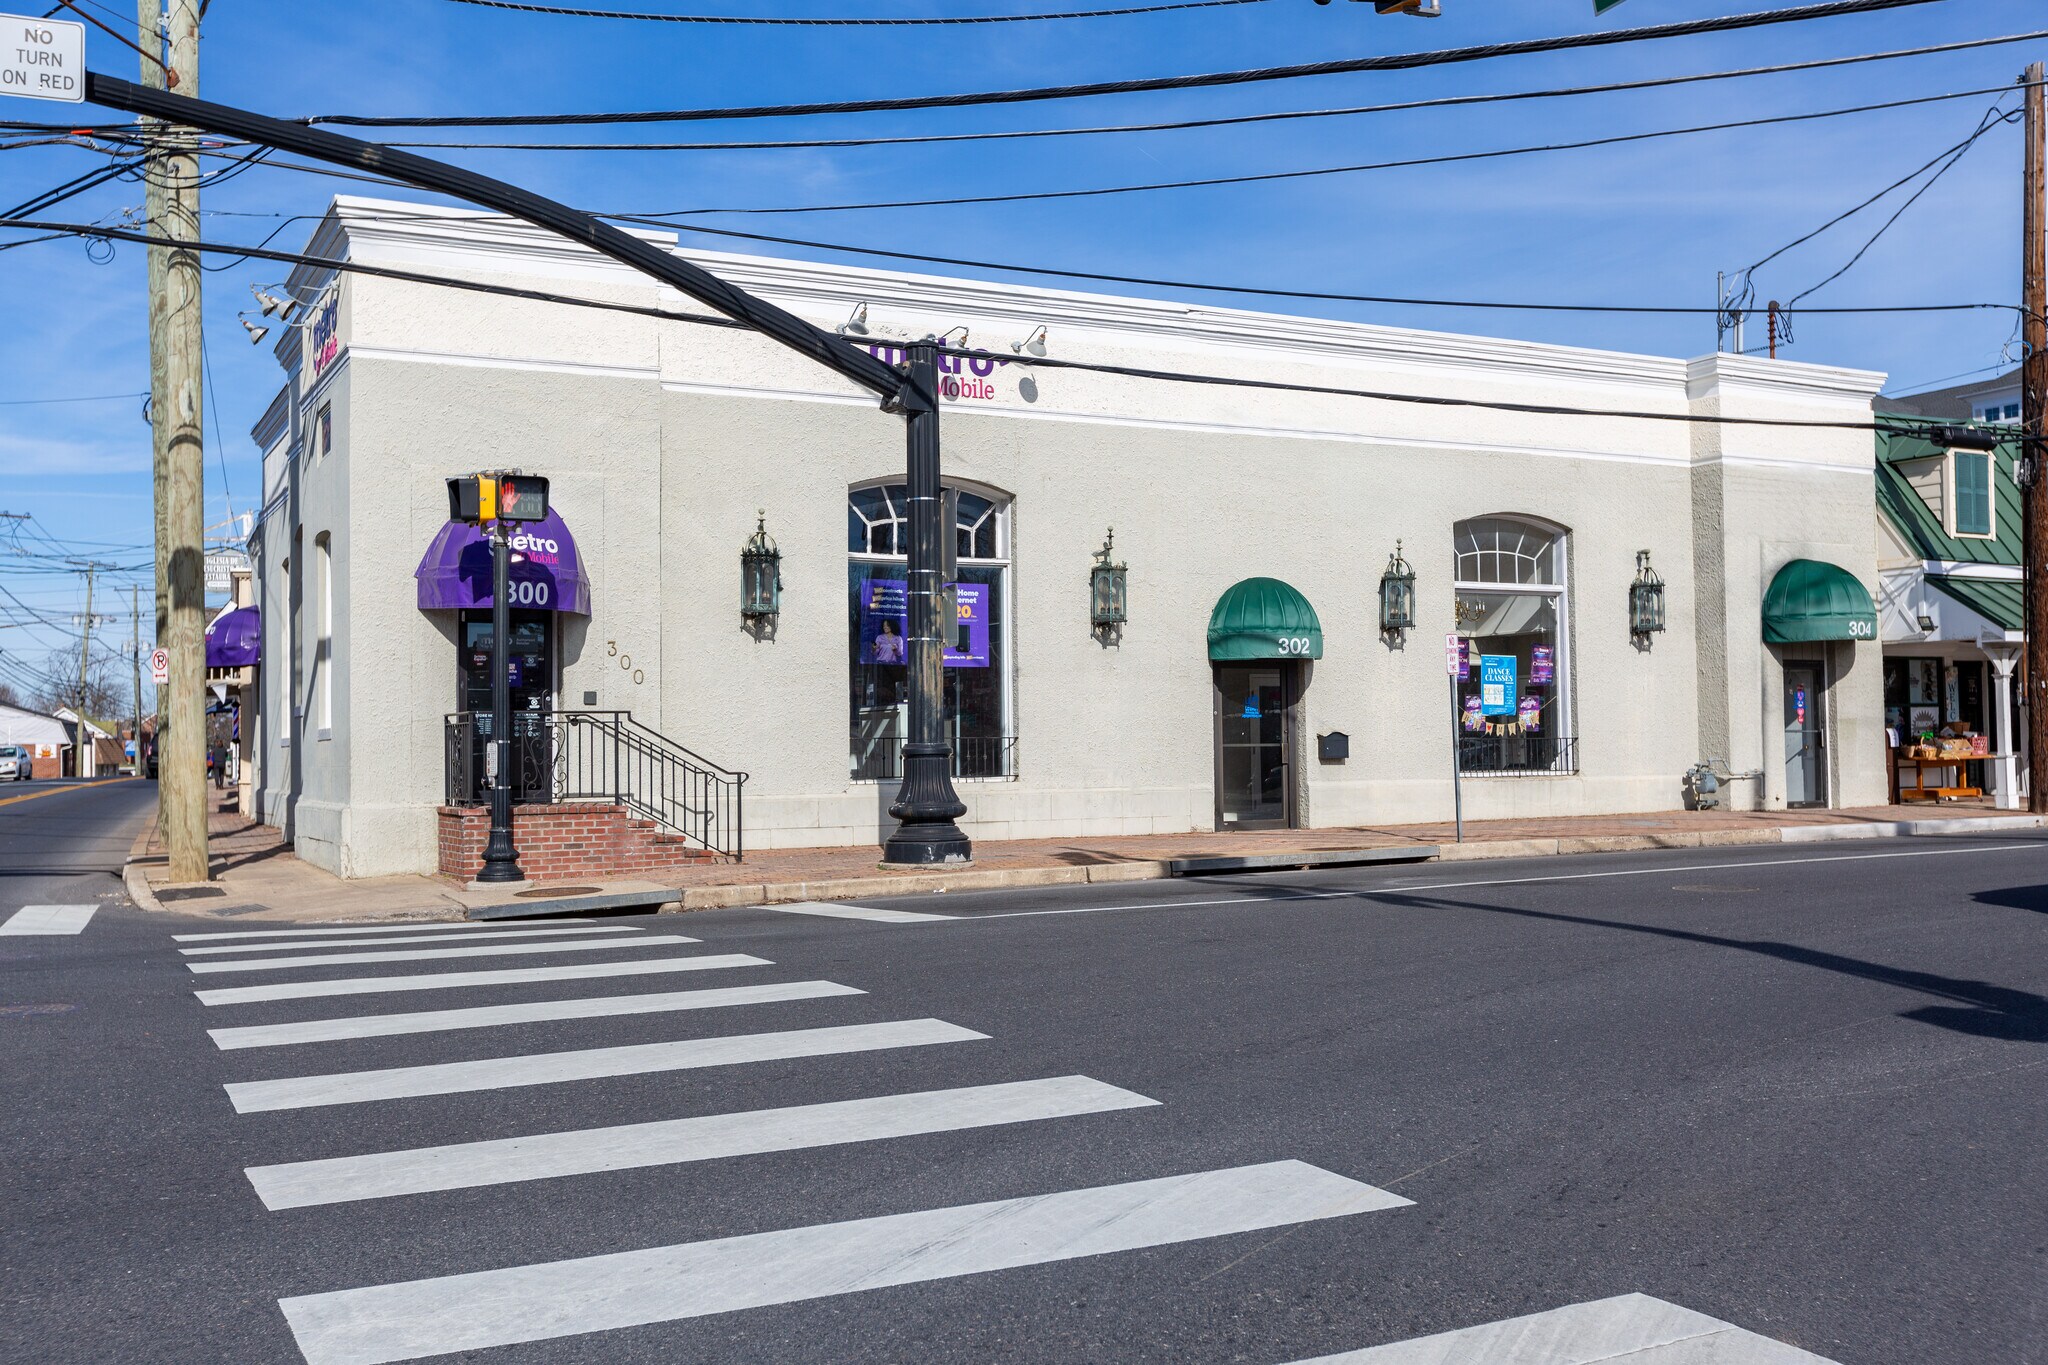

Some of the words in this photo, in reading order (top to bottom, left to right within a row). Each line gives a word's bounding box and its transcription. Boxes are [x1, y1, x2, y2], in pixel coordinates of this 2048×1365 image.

[24, 28, 53, 45] NO
[16, 48, 63, 68] TURN
[2, 69, 27, 86] ON
[40, 73, 75, 91] RED
[869, 338, 994, 377] mtro
[957, 589, 979, 597] Home
[1848, 621, 1872, 637] 304
[1278, 637, 1310, 655] 302
[607, 640, 644, 685] 300
[1487, 667, 1511, 675] DANCE
[1485, 674, 1514, 682] CLASSES
[1948, 681, 1957, 721] WELC
